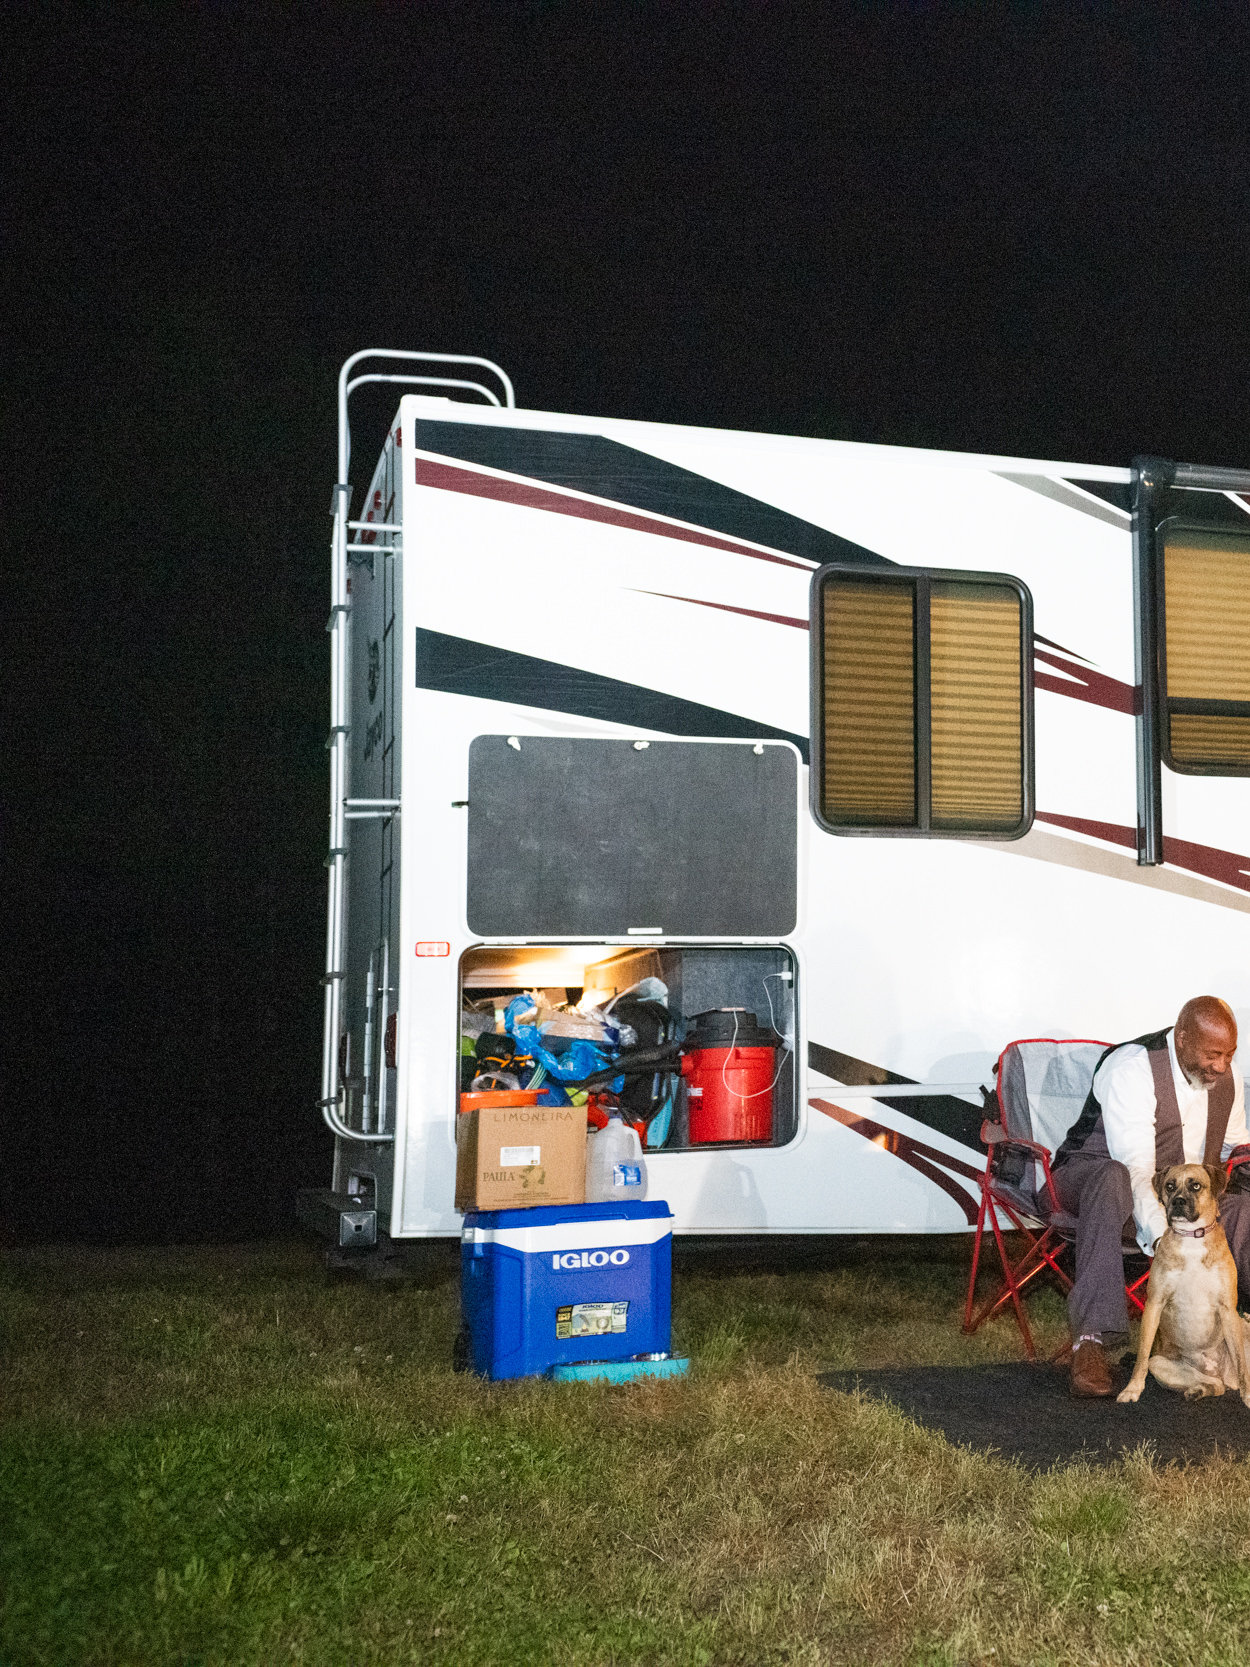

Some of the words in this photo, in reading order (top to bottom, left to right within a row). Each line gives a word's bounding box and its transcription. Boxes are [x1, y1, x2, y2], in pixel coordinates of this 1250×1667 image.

[493, 1111, 574, 1123] LIMONEIRA
[482, 1171, 516, 1182] PAULA
[552, 1249, 630, 1270] IGLOO
